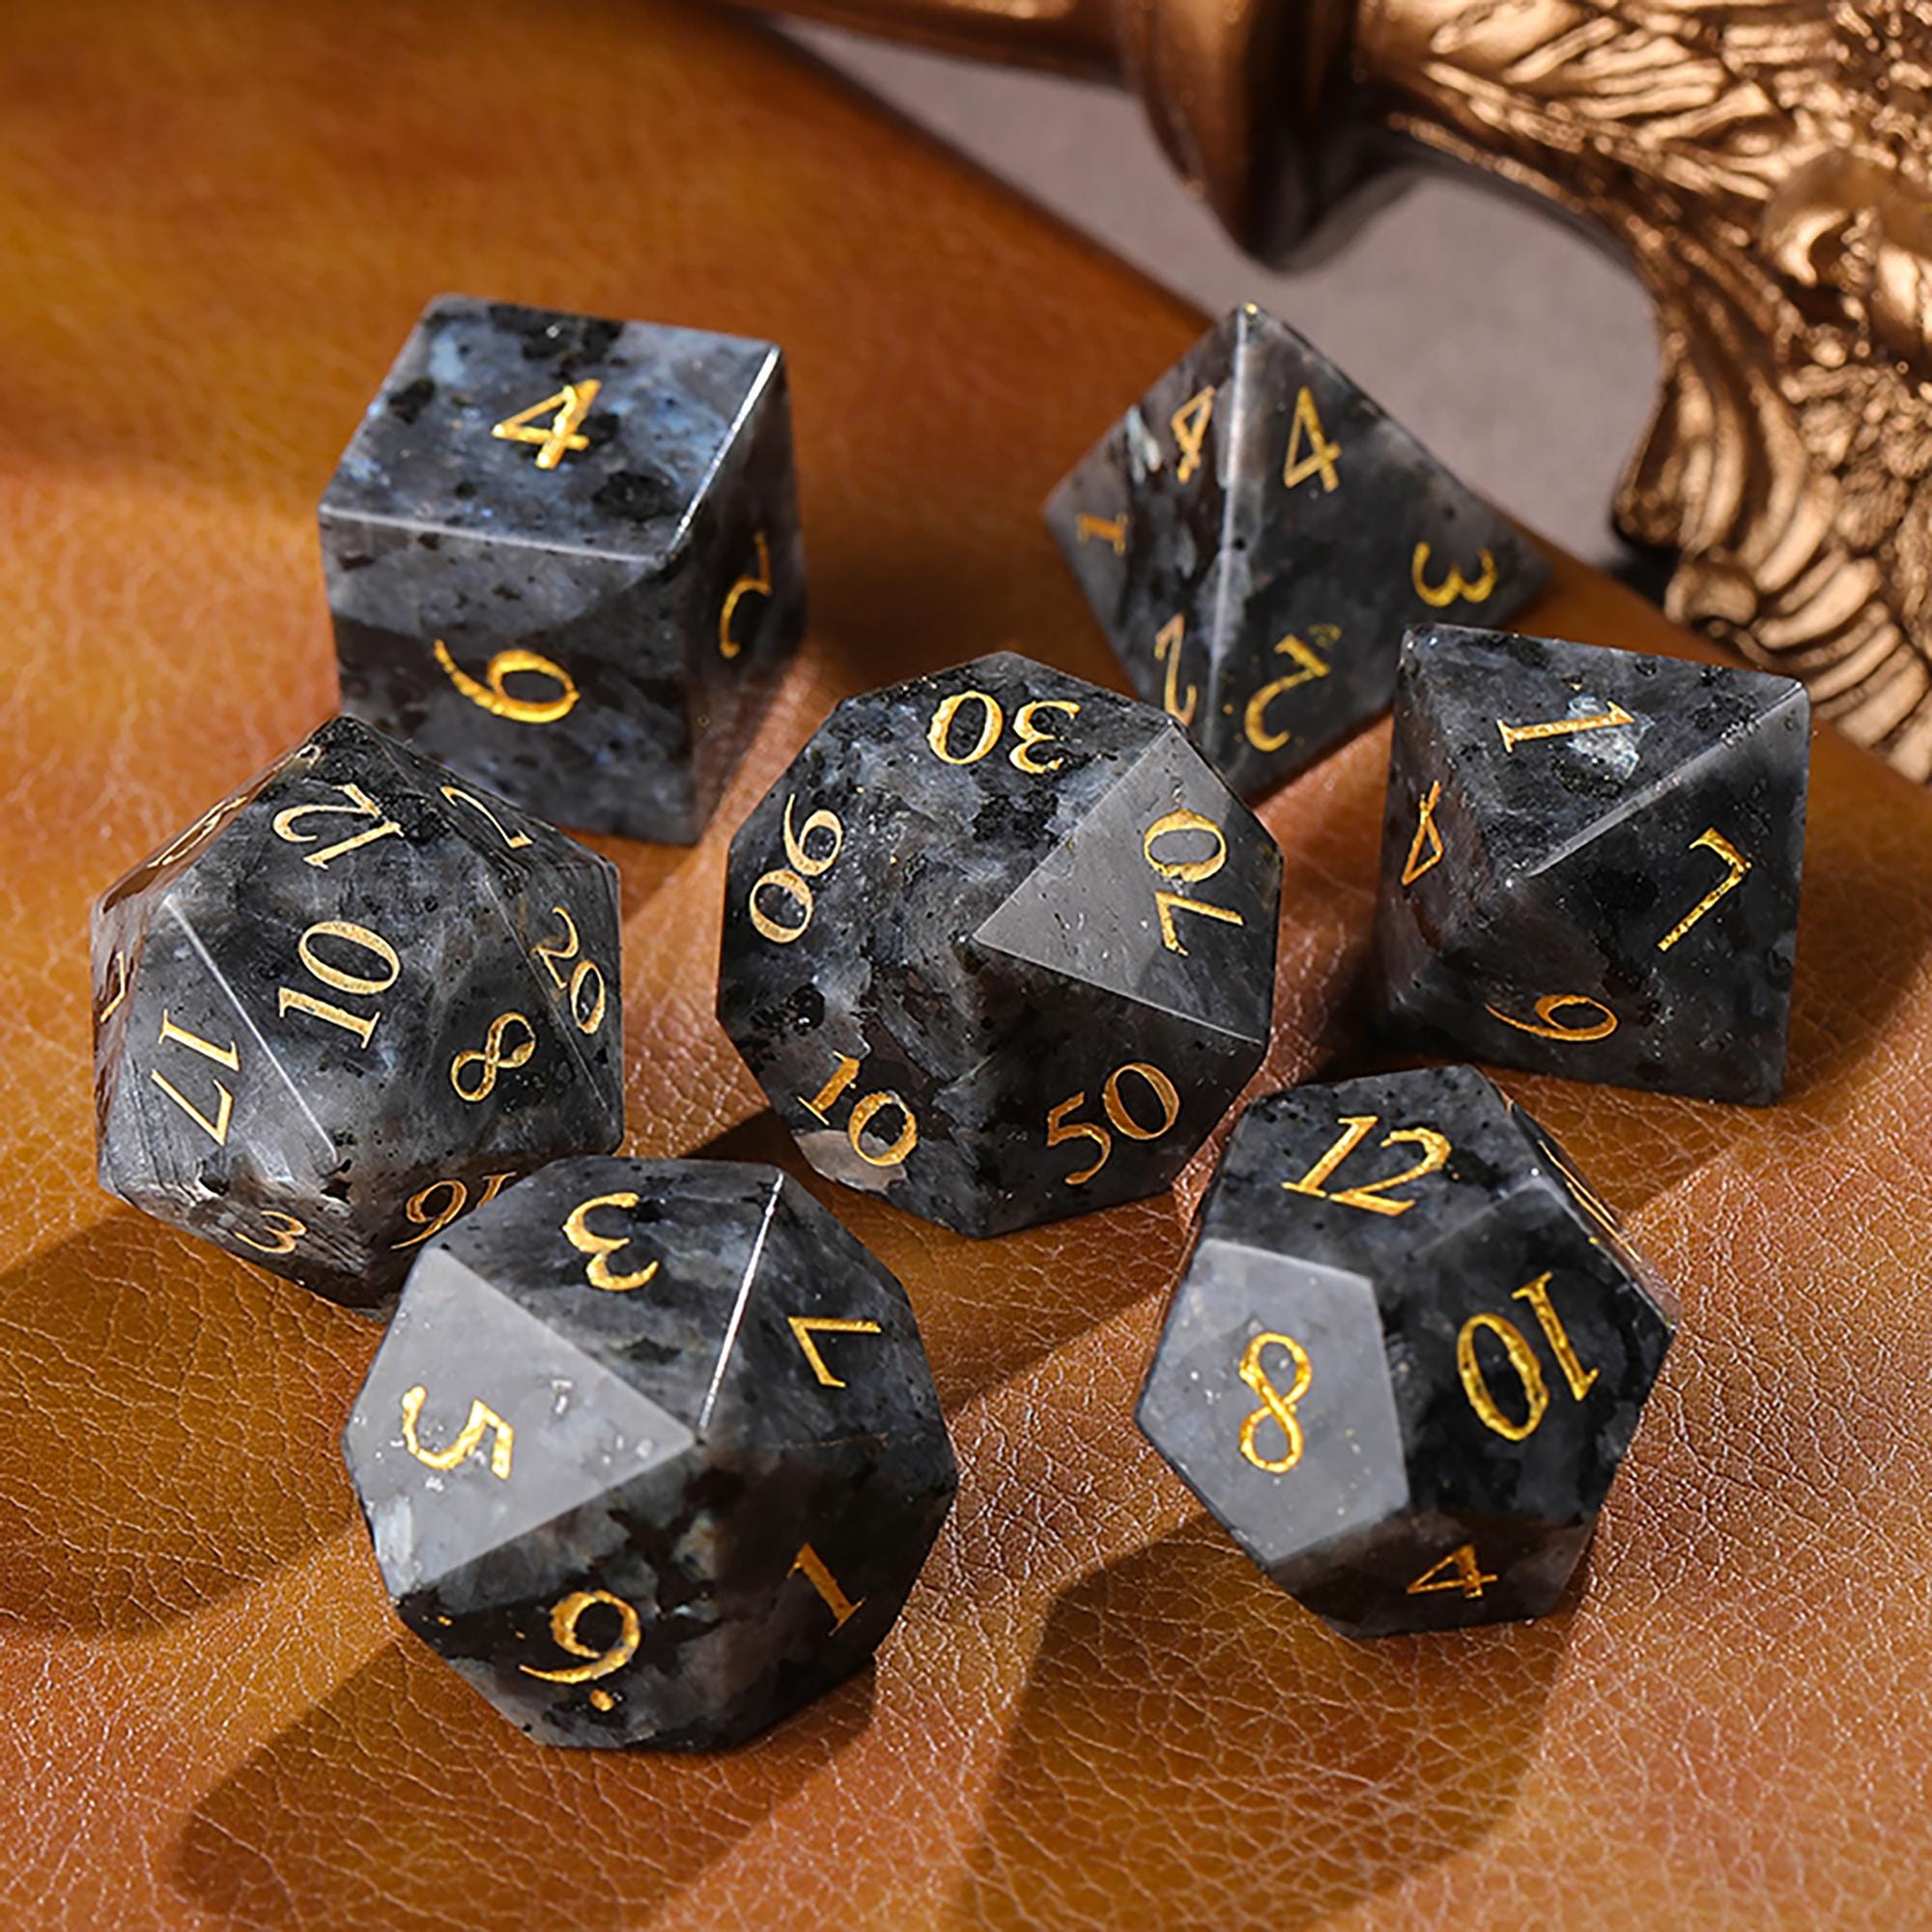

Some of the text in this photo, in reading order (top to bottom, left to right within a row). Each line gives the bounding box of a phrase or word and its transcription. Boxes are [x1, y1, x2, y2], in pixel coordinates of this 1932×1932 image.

[491, 379, 603, 469] 4
[1171, 385, 1216, 483] 4
[1284, 385, 1342, 493] 4
[1076, 511, 1127, 555] 1
[1411, 541, 1497, 607] 3
[719, 529, 772, 659] 2
[433, 639, 580, 724] 6
[926, 690, 1081, 773] 30
[1244, 634, 1330, 752] 2
[1496, 700, 1635, 753] 1
[272, 782, 404, 869] 12
[749, 793, 843, 944] 90
[1401, 781, 1444, 886] 4
[1144, 808, 1244, 956] 70
[1657, 827, 1752, 952] 7
[277, 921, 401, 1049] 10
[531, 906, 606, 1035] 20
[1485, 993, 1618, 1042] 6
[151, 1009, 241, 1147] 17
[450, 1011, 536, 1102] 8
[797, 1050, 920, 1167] 10
[1045, 1062, 1180, 1185] 50
[1281, 1116, 1453, 1216] 12
[234, 1210, 306, 1254] 3
[562, 1192, 659, 1292] 3
[787, 1316, 882, 1389] 7
[1238, 1332, 1313, 1473] 8
[1457, 1271, 1600, 1441] 10
[402, 1385, 514, 1481] 5
[785, 1543, 867, 1637] 1
[1406, 1546, 1498, 1599] 4
